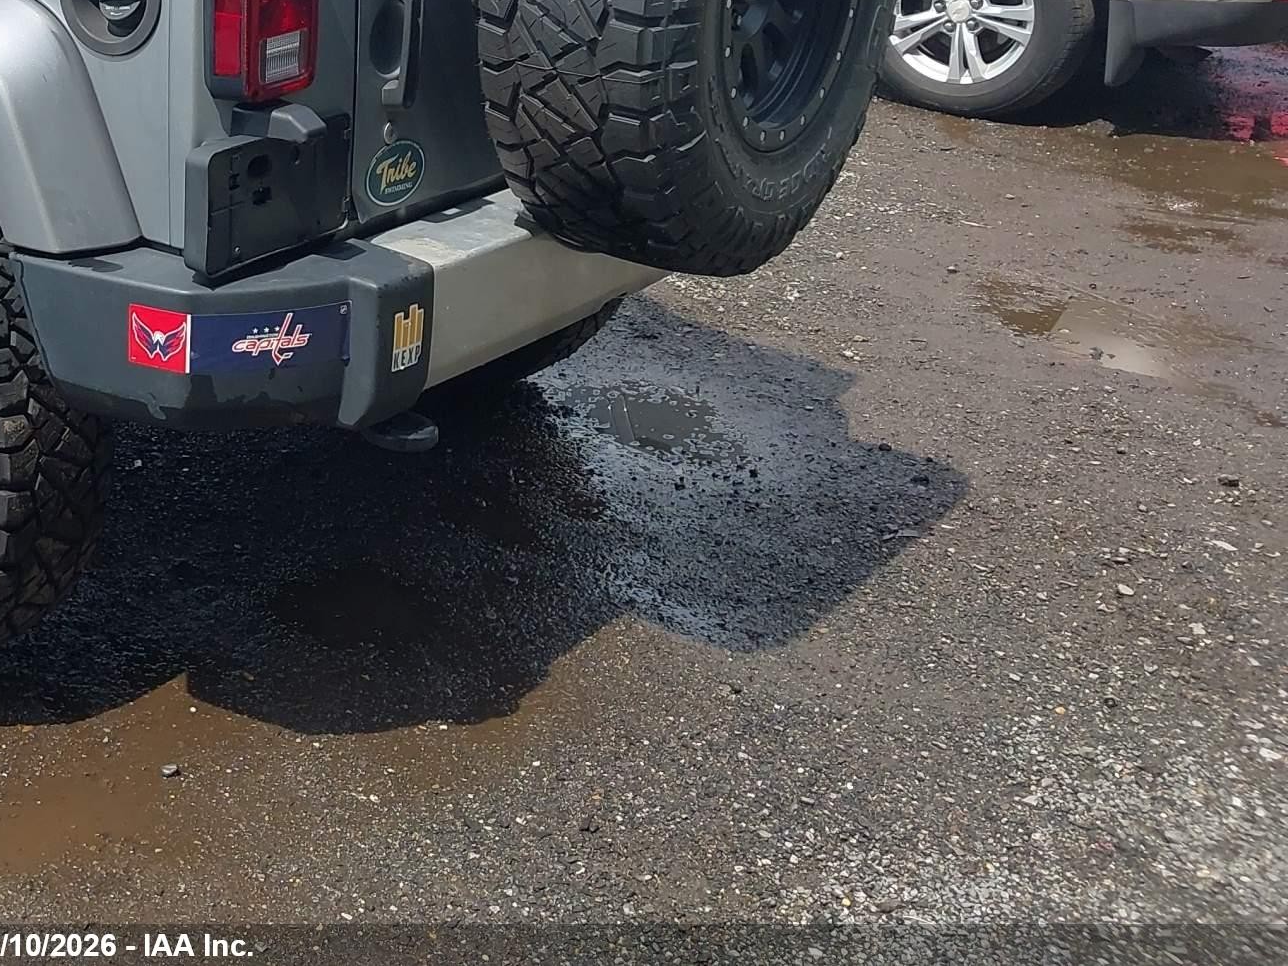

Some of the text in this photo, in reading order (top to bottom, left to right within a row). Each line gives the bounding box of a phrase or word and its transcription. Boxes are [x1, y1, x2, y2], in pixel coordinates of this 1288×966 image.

[376, 150, 417, 194] Tribe
[232, 313, 312, 366] capitals
[393, 344, 421, 371] KEXP
